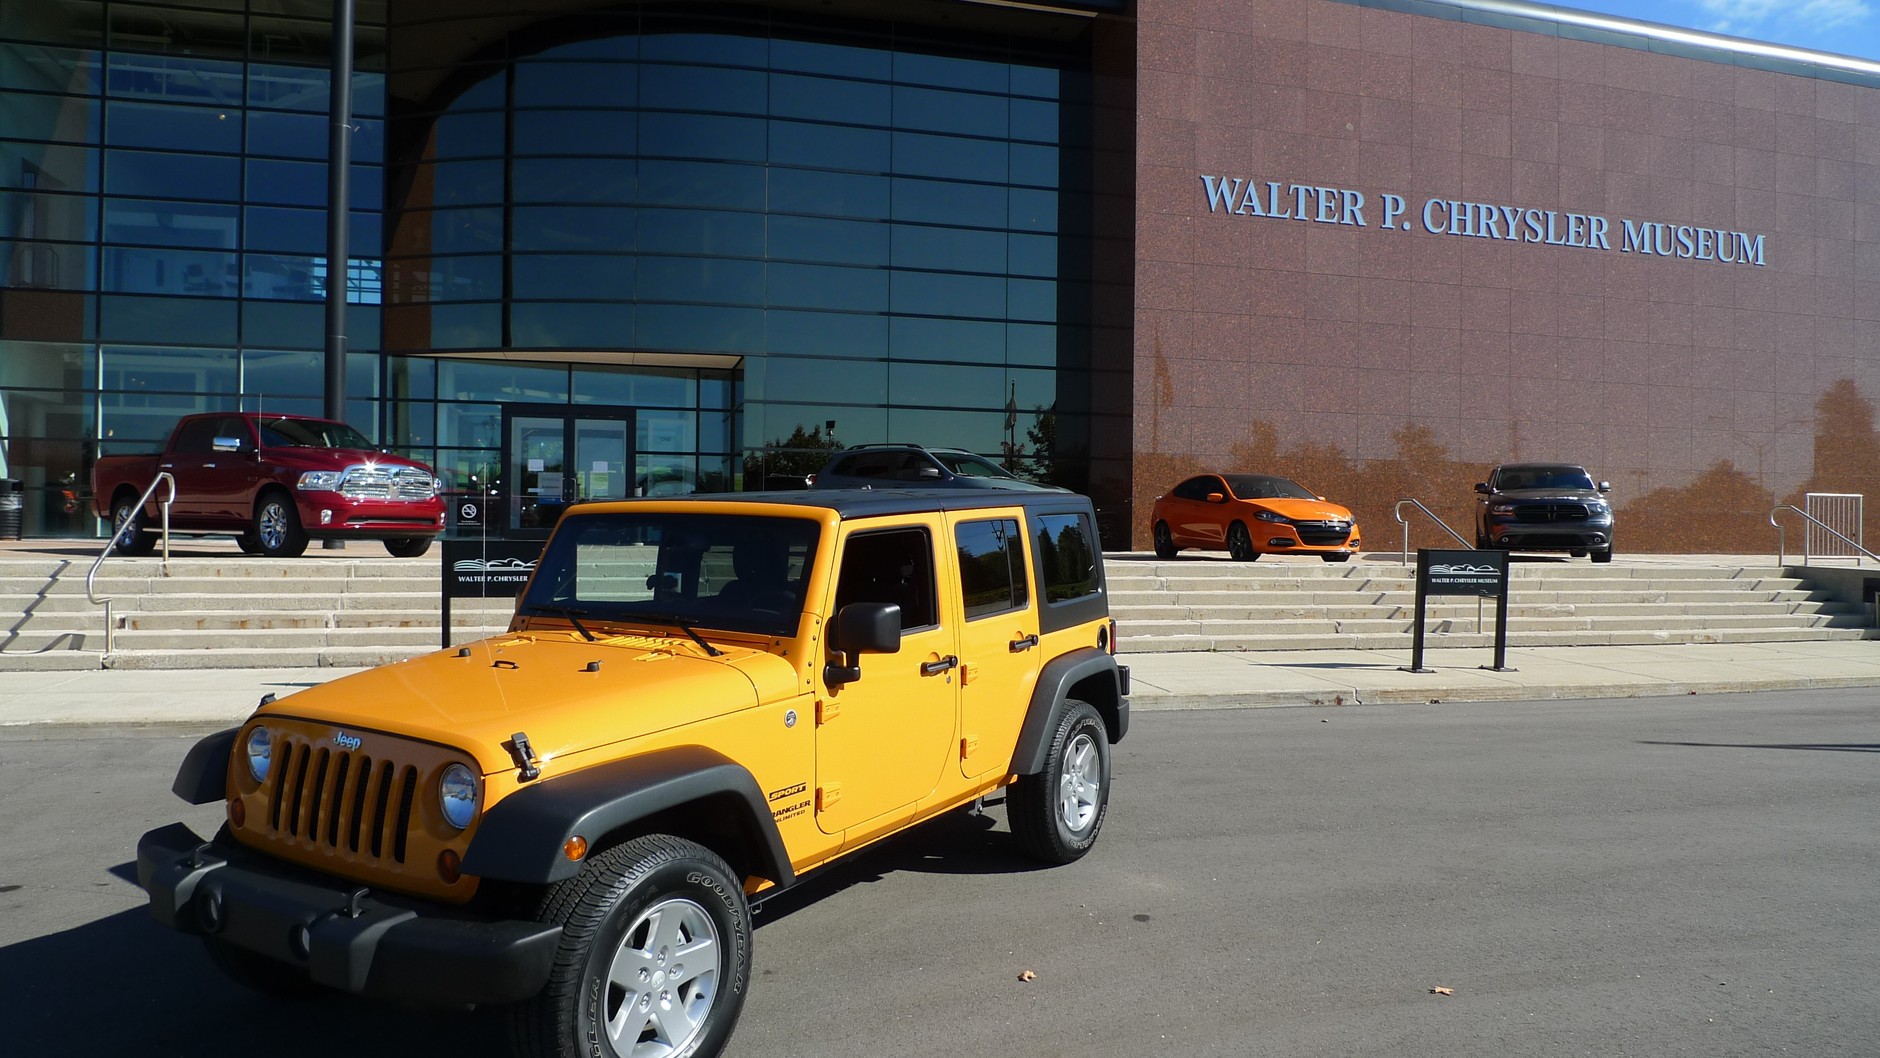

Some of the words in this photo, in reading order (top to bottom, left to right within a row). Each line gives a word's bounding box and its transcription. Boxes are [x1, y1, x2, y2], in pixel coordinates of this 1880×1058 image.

[1200, 174, 1367, 227] WALTER
[1381, 193, 1411, 231] P.
[1421, 198, 1611, 250] CHRYSLER
[1621, 218, 1766, 267] MUSEUM
[333, 731, 362, 751] Jeep
[770, 785, 805, 800] SPORT
[772, 800, 811, 817] RANGLER
[774, 810, 806, 823] NLIMITED
[687, 871, 746, 995] GOODYEAR
[586, 976, 601, 1058] GLER
